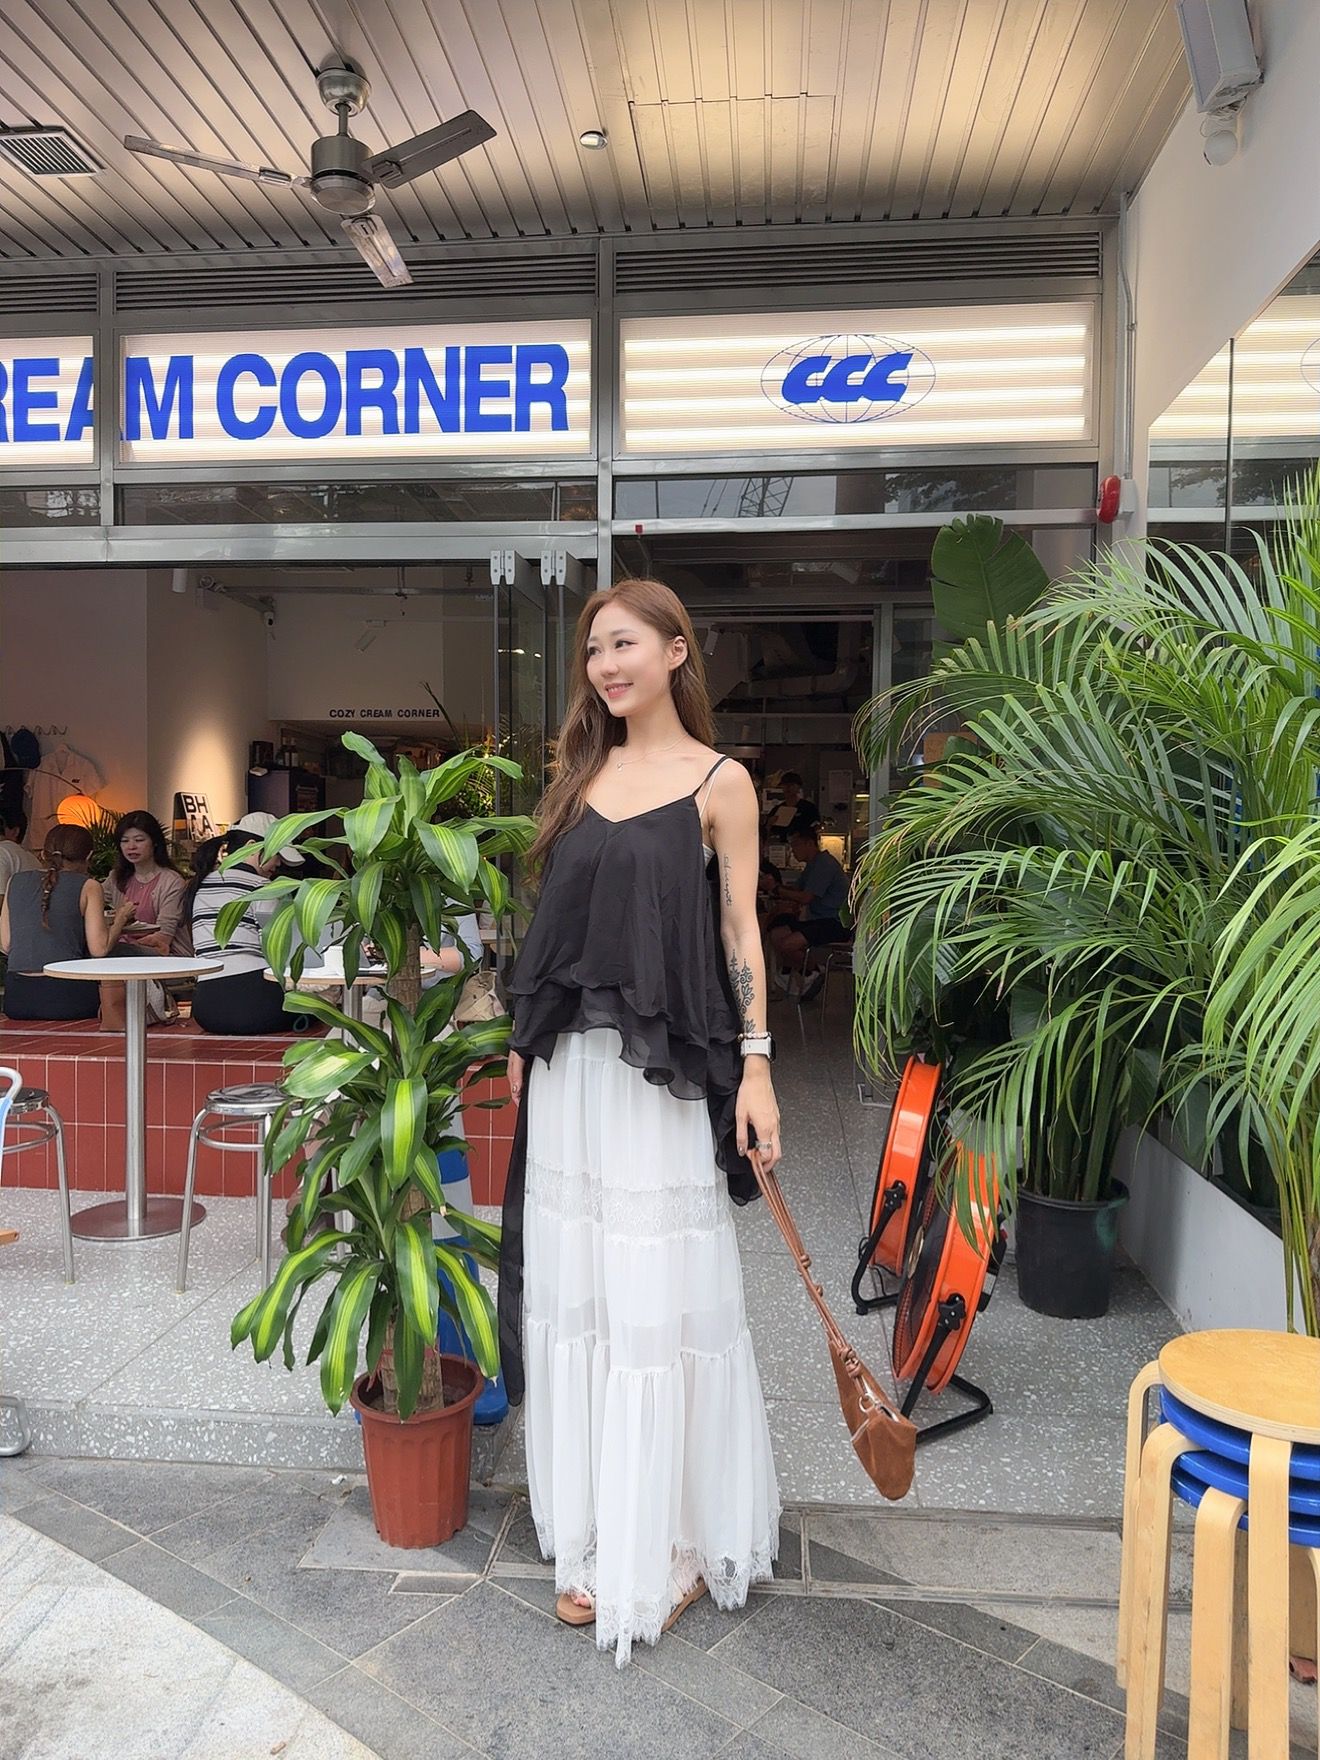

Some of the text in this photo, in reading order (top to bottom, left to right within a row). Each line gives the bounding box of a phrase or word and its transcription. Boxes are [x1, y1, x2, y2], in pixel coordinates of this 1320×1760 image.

[0, 344, 570, 442] EAM CORNER
[329, 708, 440, 718] COZY CREAM CORNER
[182, 794, 208, 813] BH
